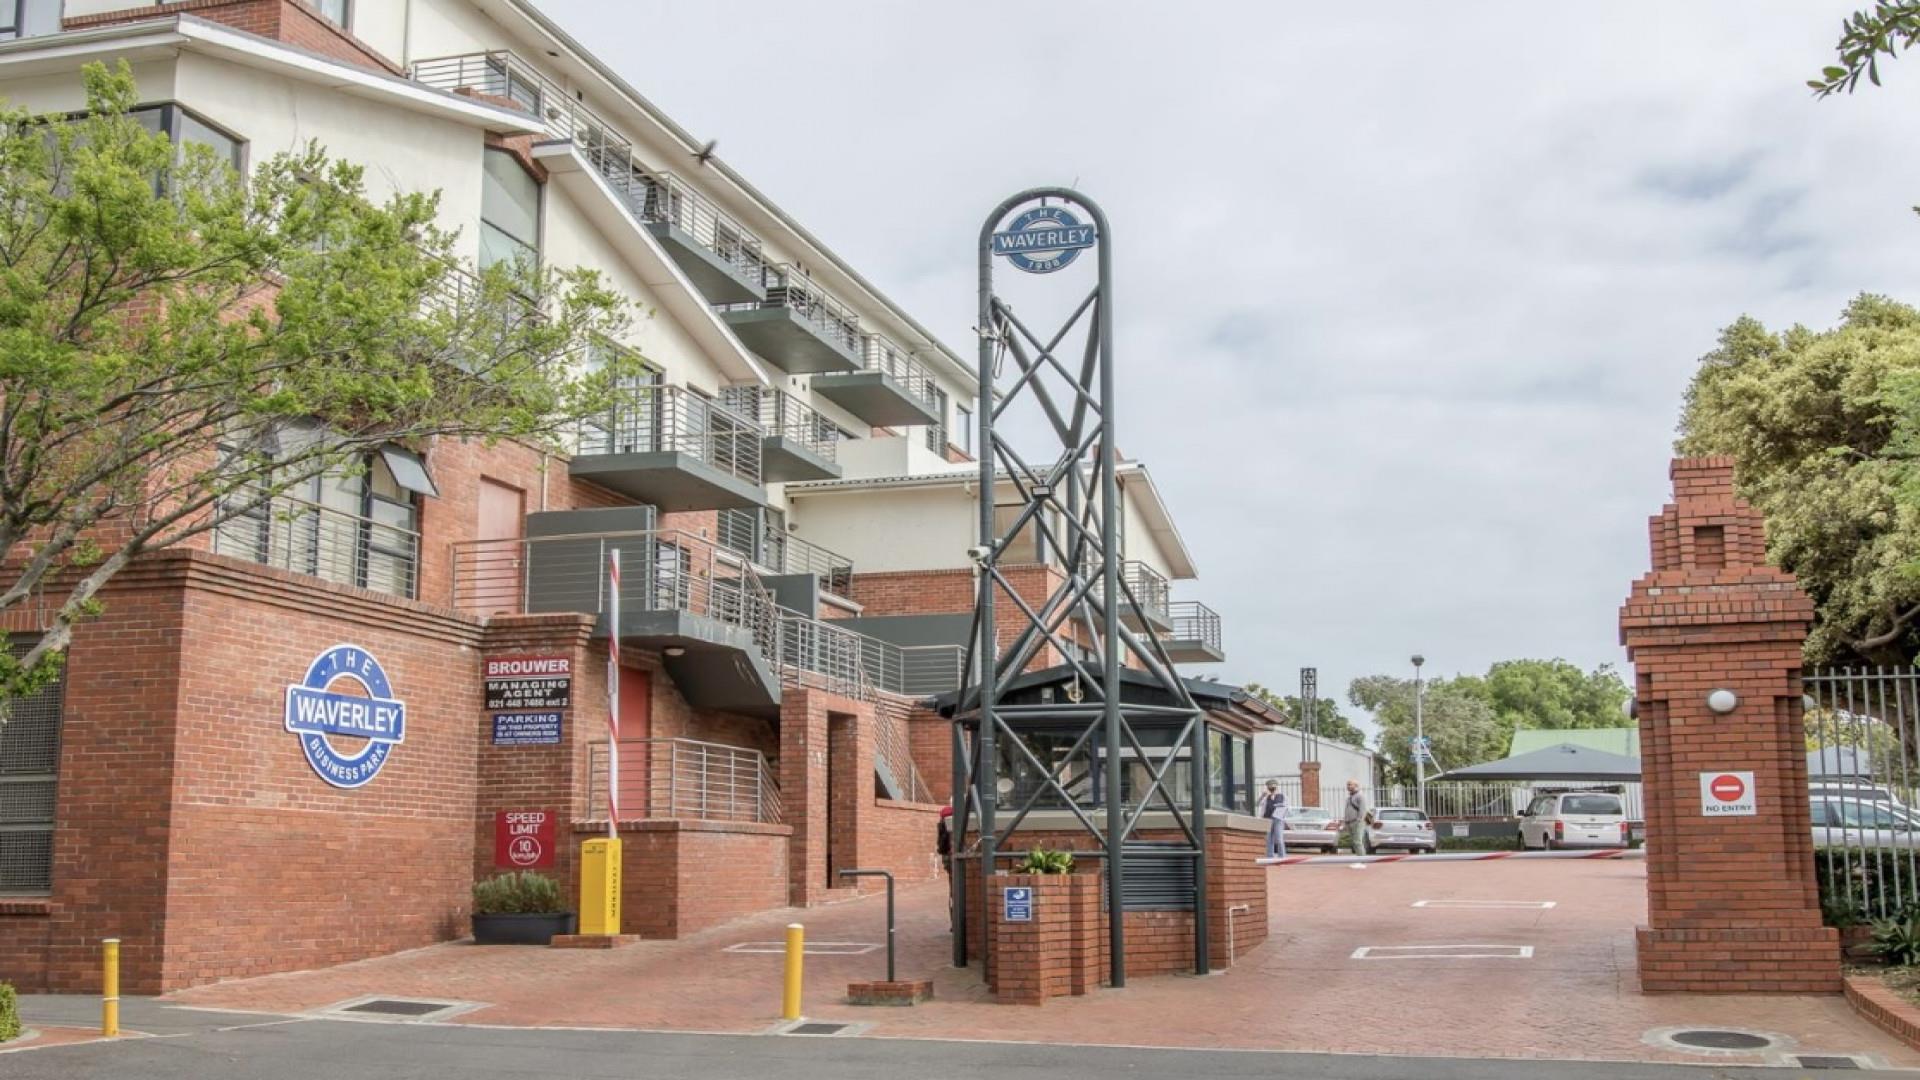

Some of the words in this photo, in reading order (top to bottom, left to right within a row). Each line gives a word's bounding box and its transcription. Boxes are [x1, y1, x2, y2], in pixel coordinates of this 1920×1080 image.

[1024, 209, 1062, 220] THE
[1000, 229, 1088, 248] WAVERLEY
[329, 650, 373, 677] THE
[488, 659, 569, 674] BROUWER
[488, 680, 567, 690] MANAGING
[503, 689, 552, 698] AGENT
[296, 694, 399, 733] WAVERLEY
[497, 714, 557, 723] PARKING
[310, 738, 359, 780] BUSINESS
[360, 744, 385, 777] PARK
[1721, 804, 1752, 812] ENTRY
[505, 812, 545, 824] SPEED
[509, 823, 540, 835] LIMIT
[519, 840, 532, 852] 10
